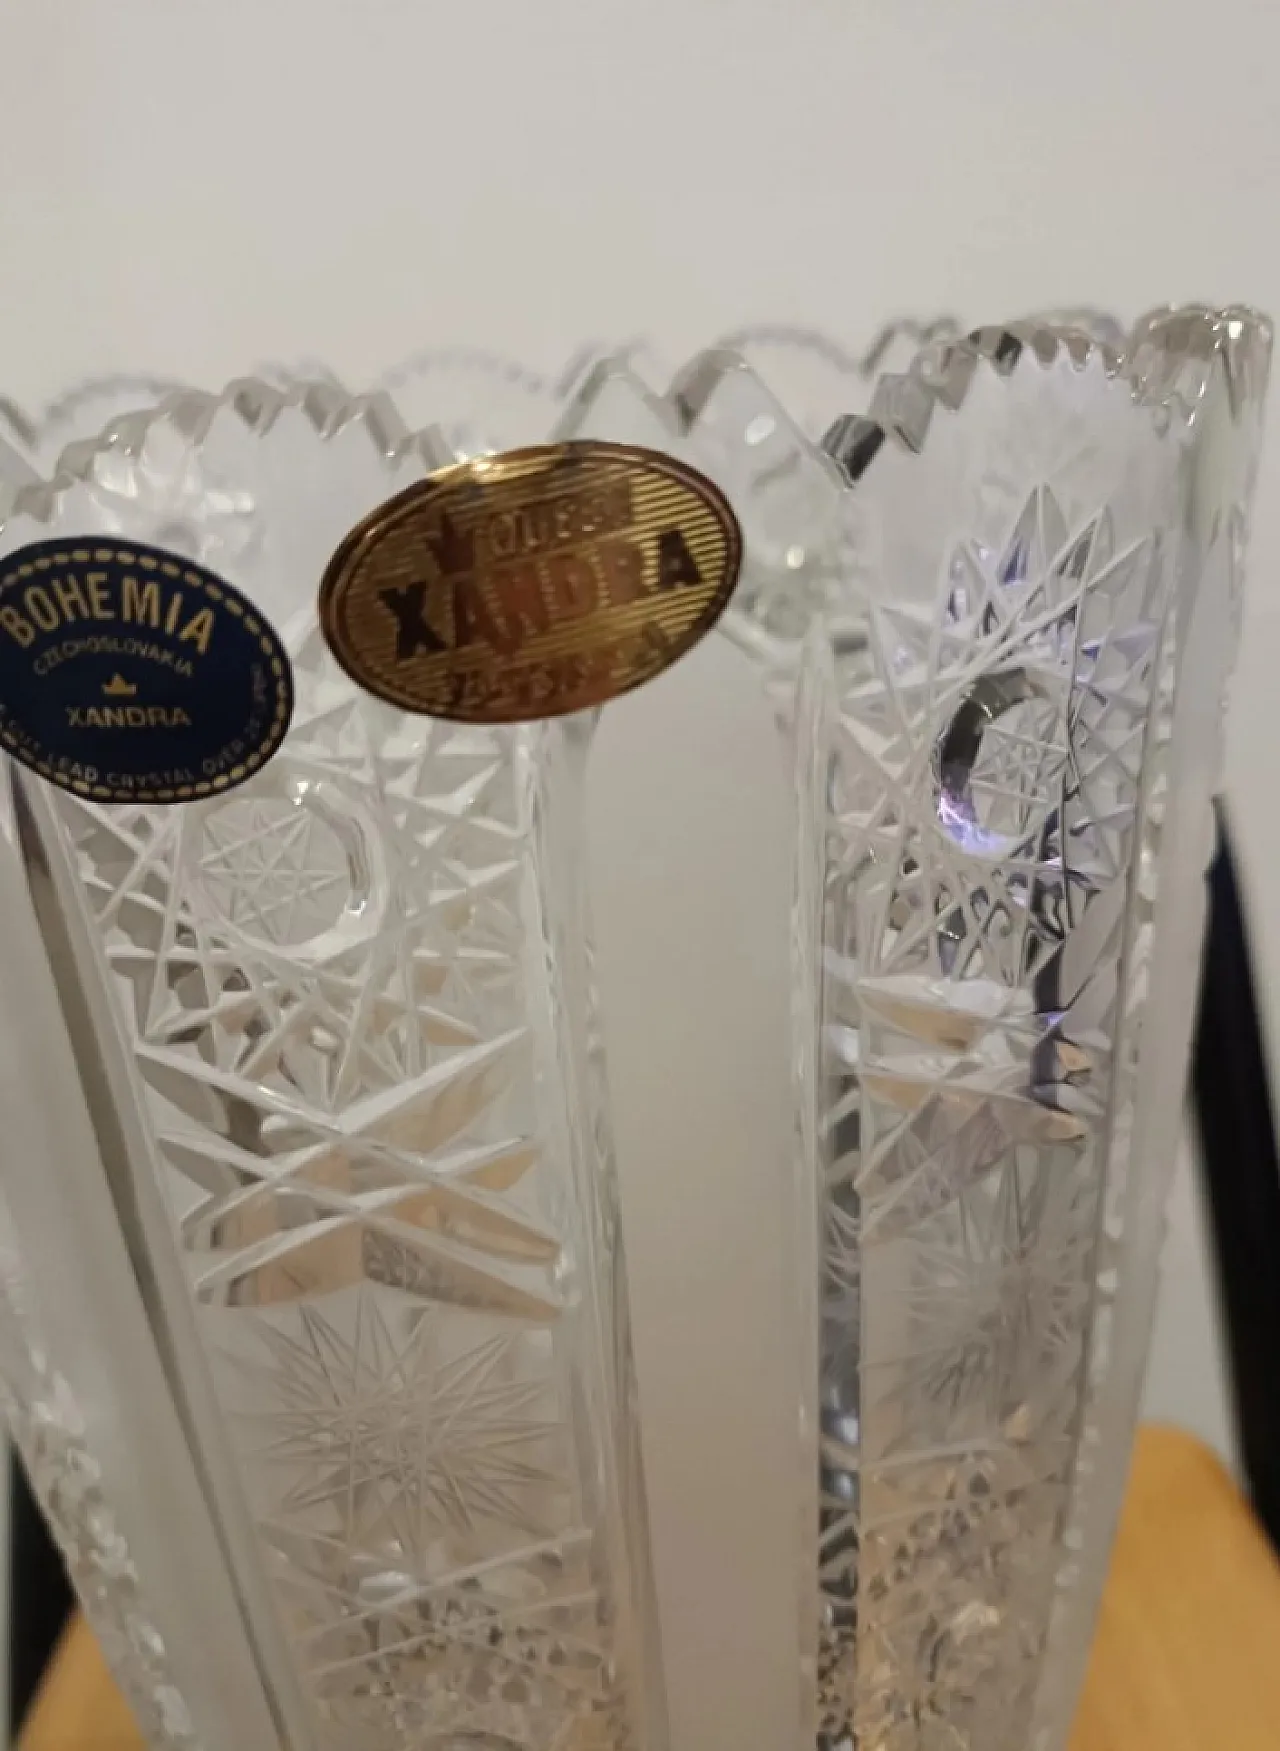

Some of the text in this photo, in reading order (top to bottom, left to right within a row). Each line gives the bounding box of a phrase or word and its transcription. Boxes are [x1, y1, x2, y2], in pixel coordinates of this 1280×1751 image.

[0, 572, 215, 654] BOHEMIA
[378, 529, 702, 662] XANDRA
[64, 705, 192, 727] XANDRA
